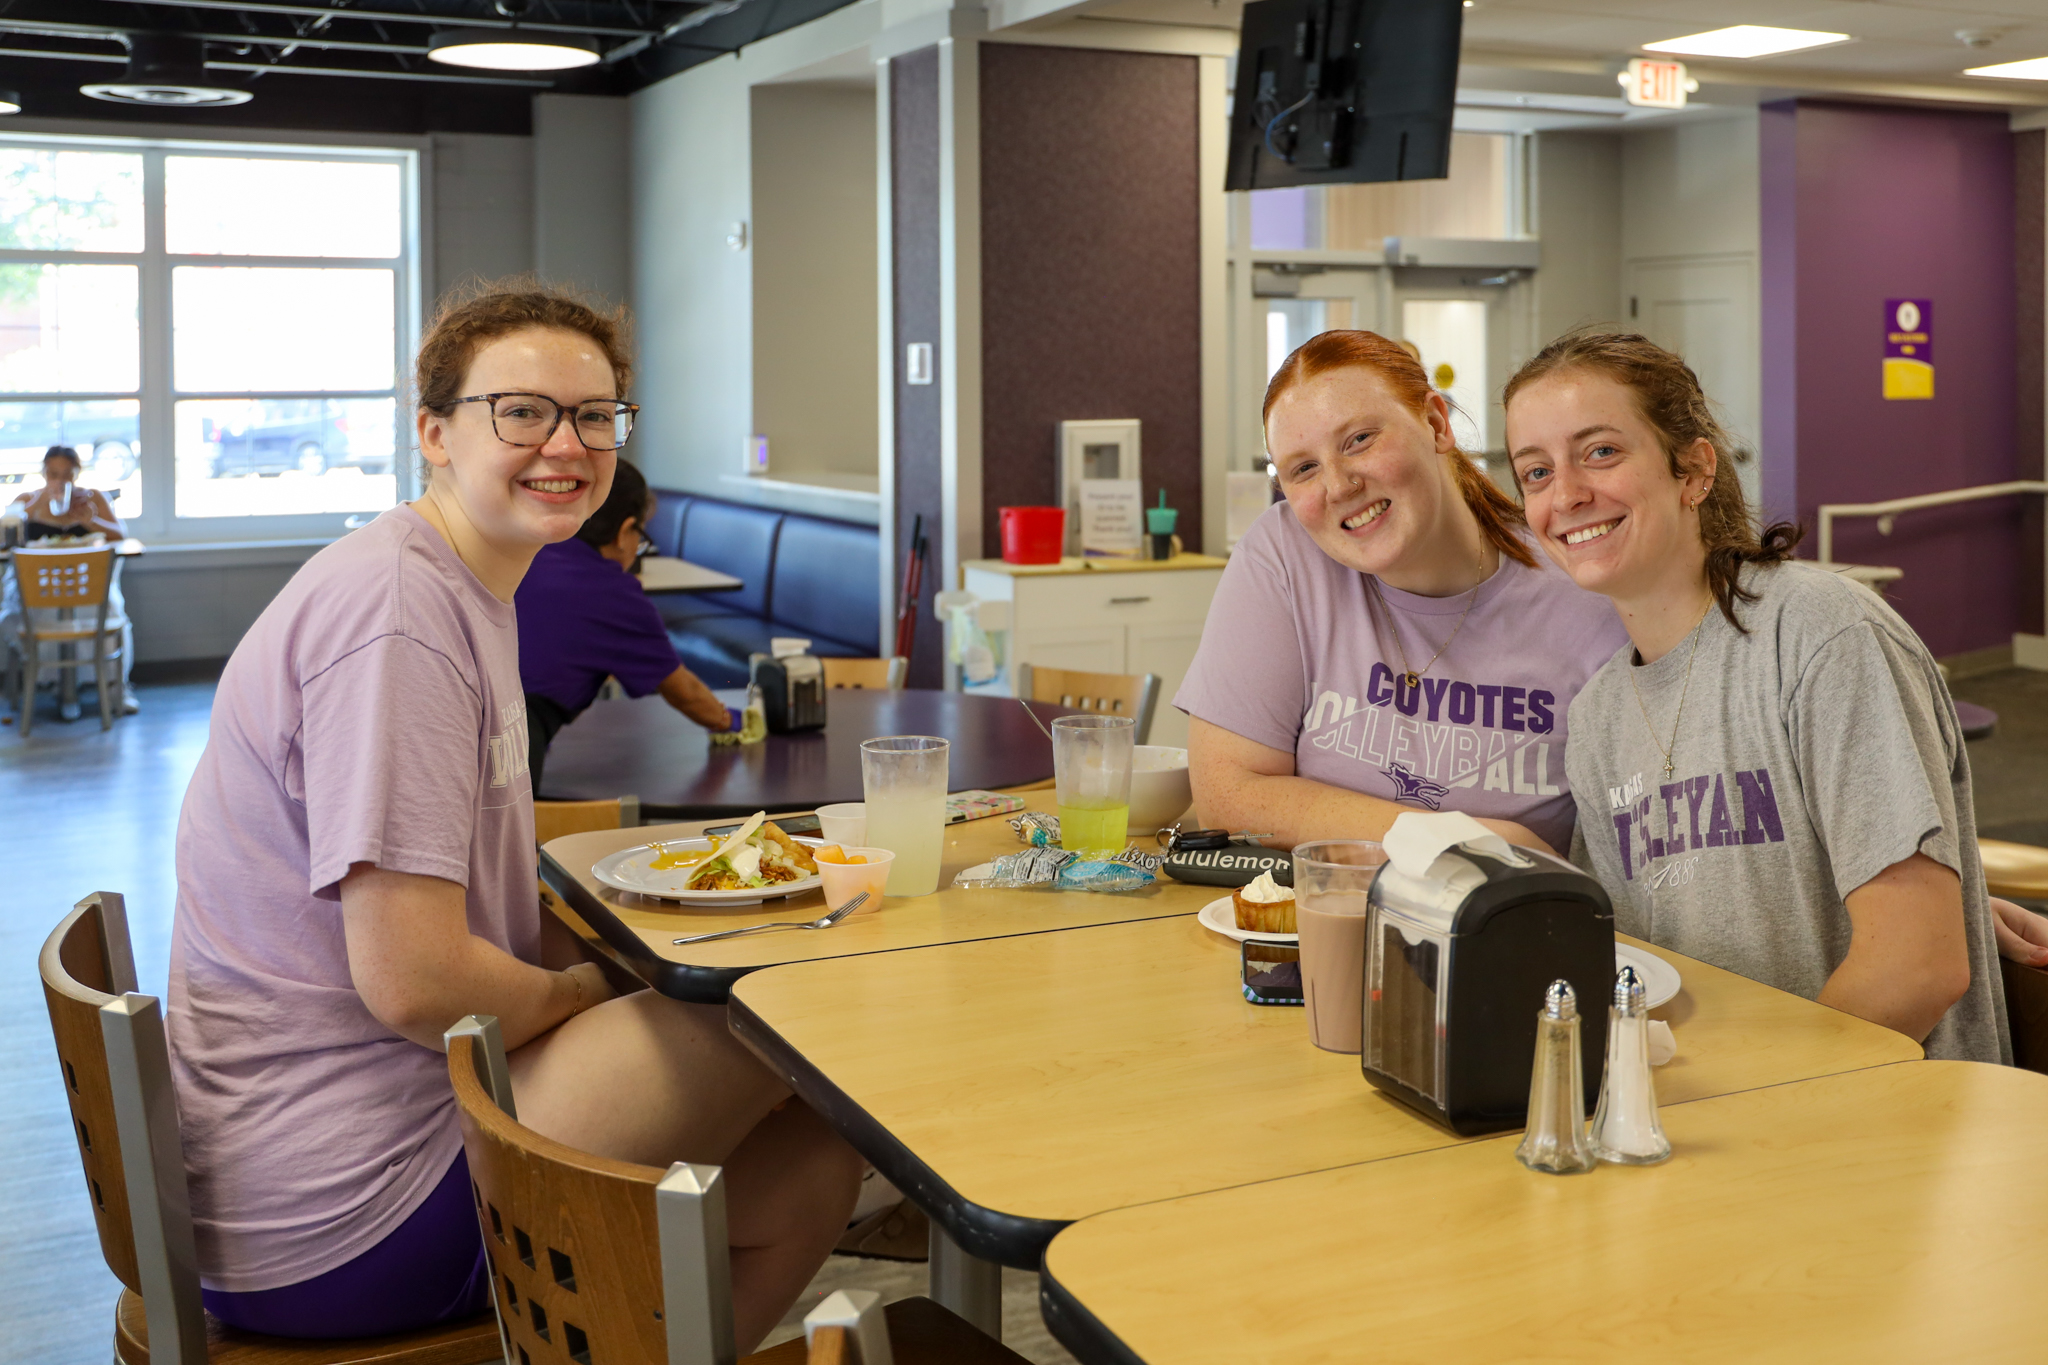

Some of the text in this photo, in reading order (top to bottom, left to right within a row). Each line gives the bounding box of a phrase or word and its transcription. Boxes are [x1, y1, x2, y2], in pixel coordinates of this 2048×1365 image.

[1640, 61, 1680, 102] EXIT
[1367, 662, 1555, 734] COYOTES
[1107, 851, 1156, 870] OYSTE
